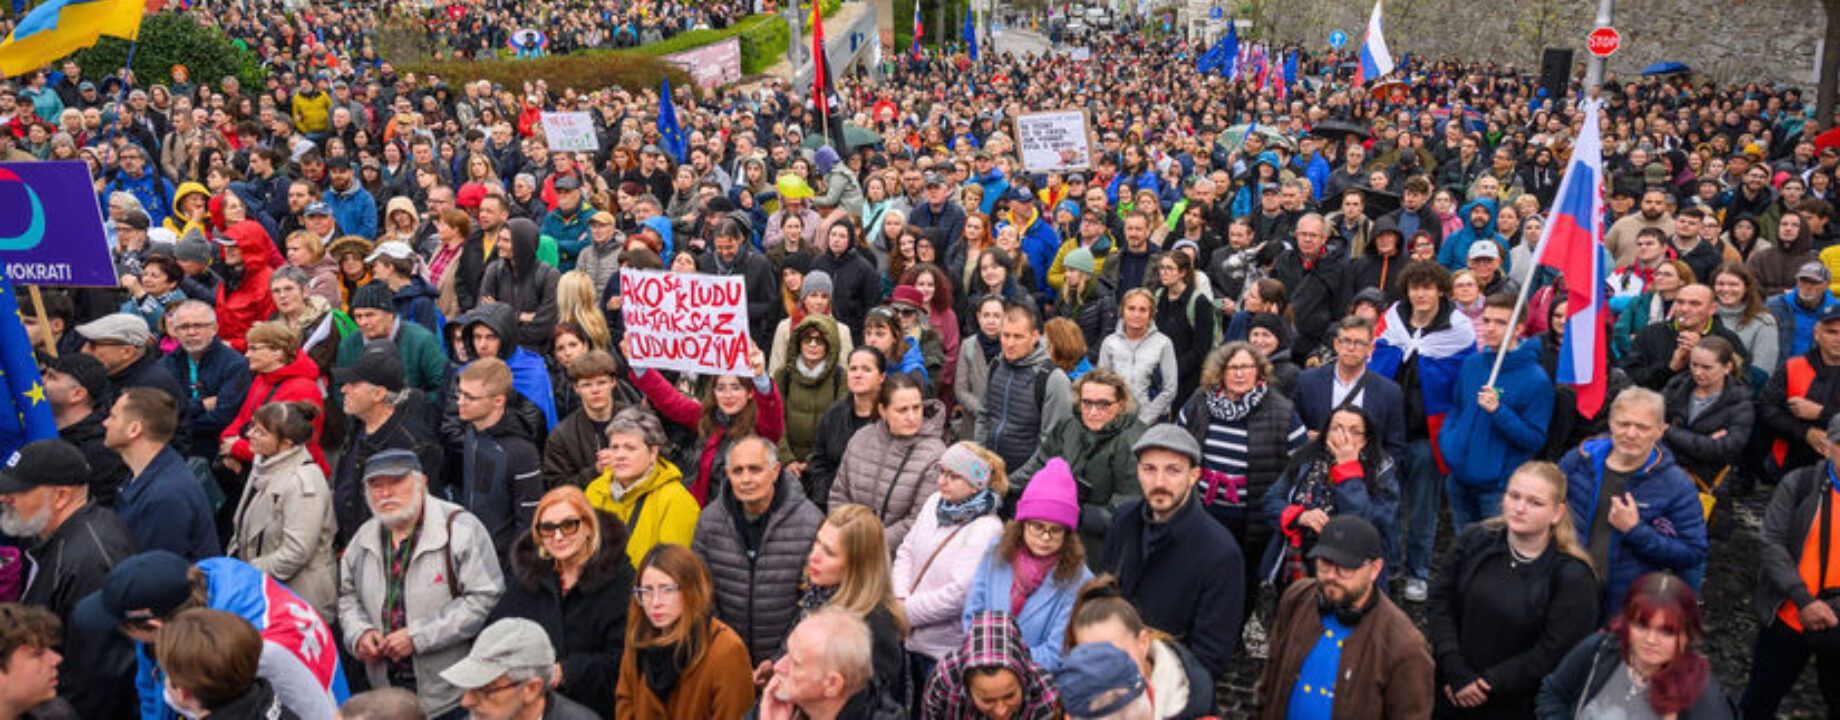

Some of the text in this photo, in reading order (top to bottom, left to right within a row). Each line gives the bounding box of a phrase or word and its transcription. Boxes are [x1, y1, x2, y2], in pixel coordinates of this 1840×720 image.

[1589, 35, 1619, 47] STOP
[621, 274, 663, 307] AKO
[675, 290, 690, 313] K
[712, 313, 735, 335] Z
